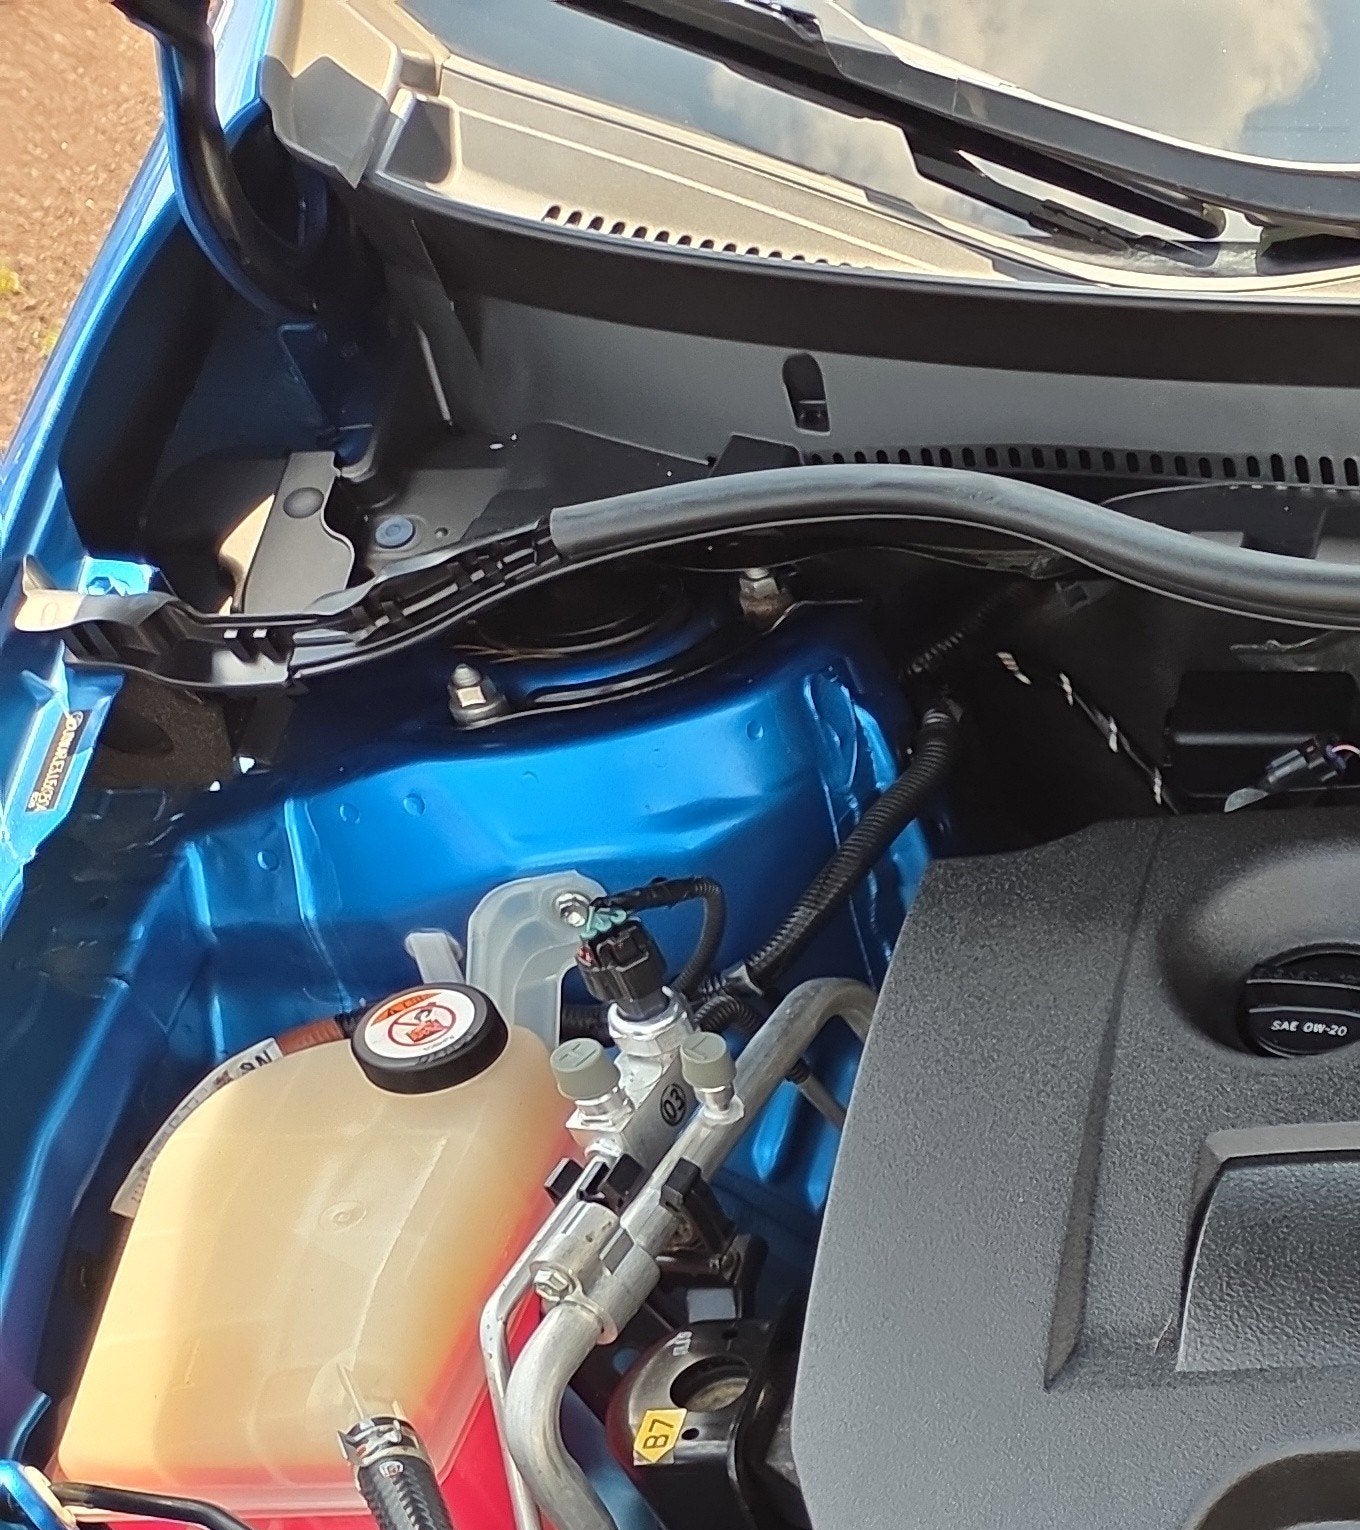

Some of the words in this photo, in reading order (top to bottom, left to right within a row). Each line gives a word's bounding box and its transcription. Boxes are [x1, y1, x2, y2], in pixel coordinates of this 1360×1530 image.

[1270, 1020, 1300, 1032] SAE
[1303, 1021, 1348, 1037] 0W-20
[644, 1418, 675, 1451] B7
